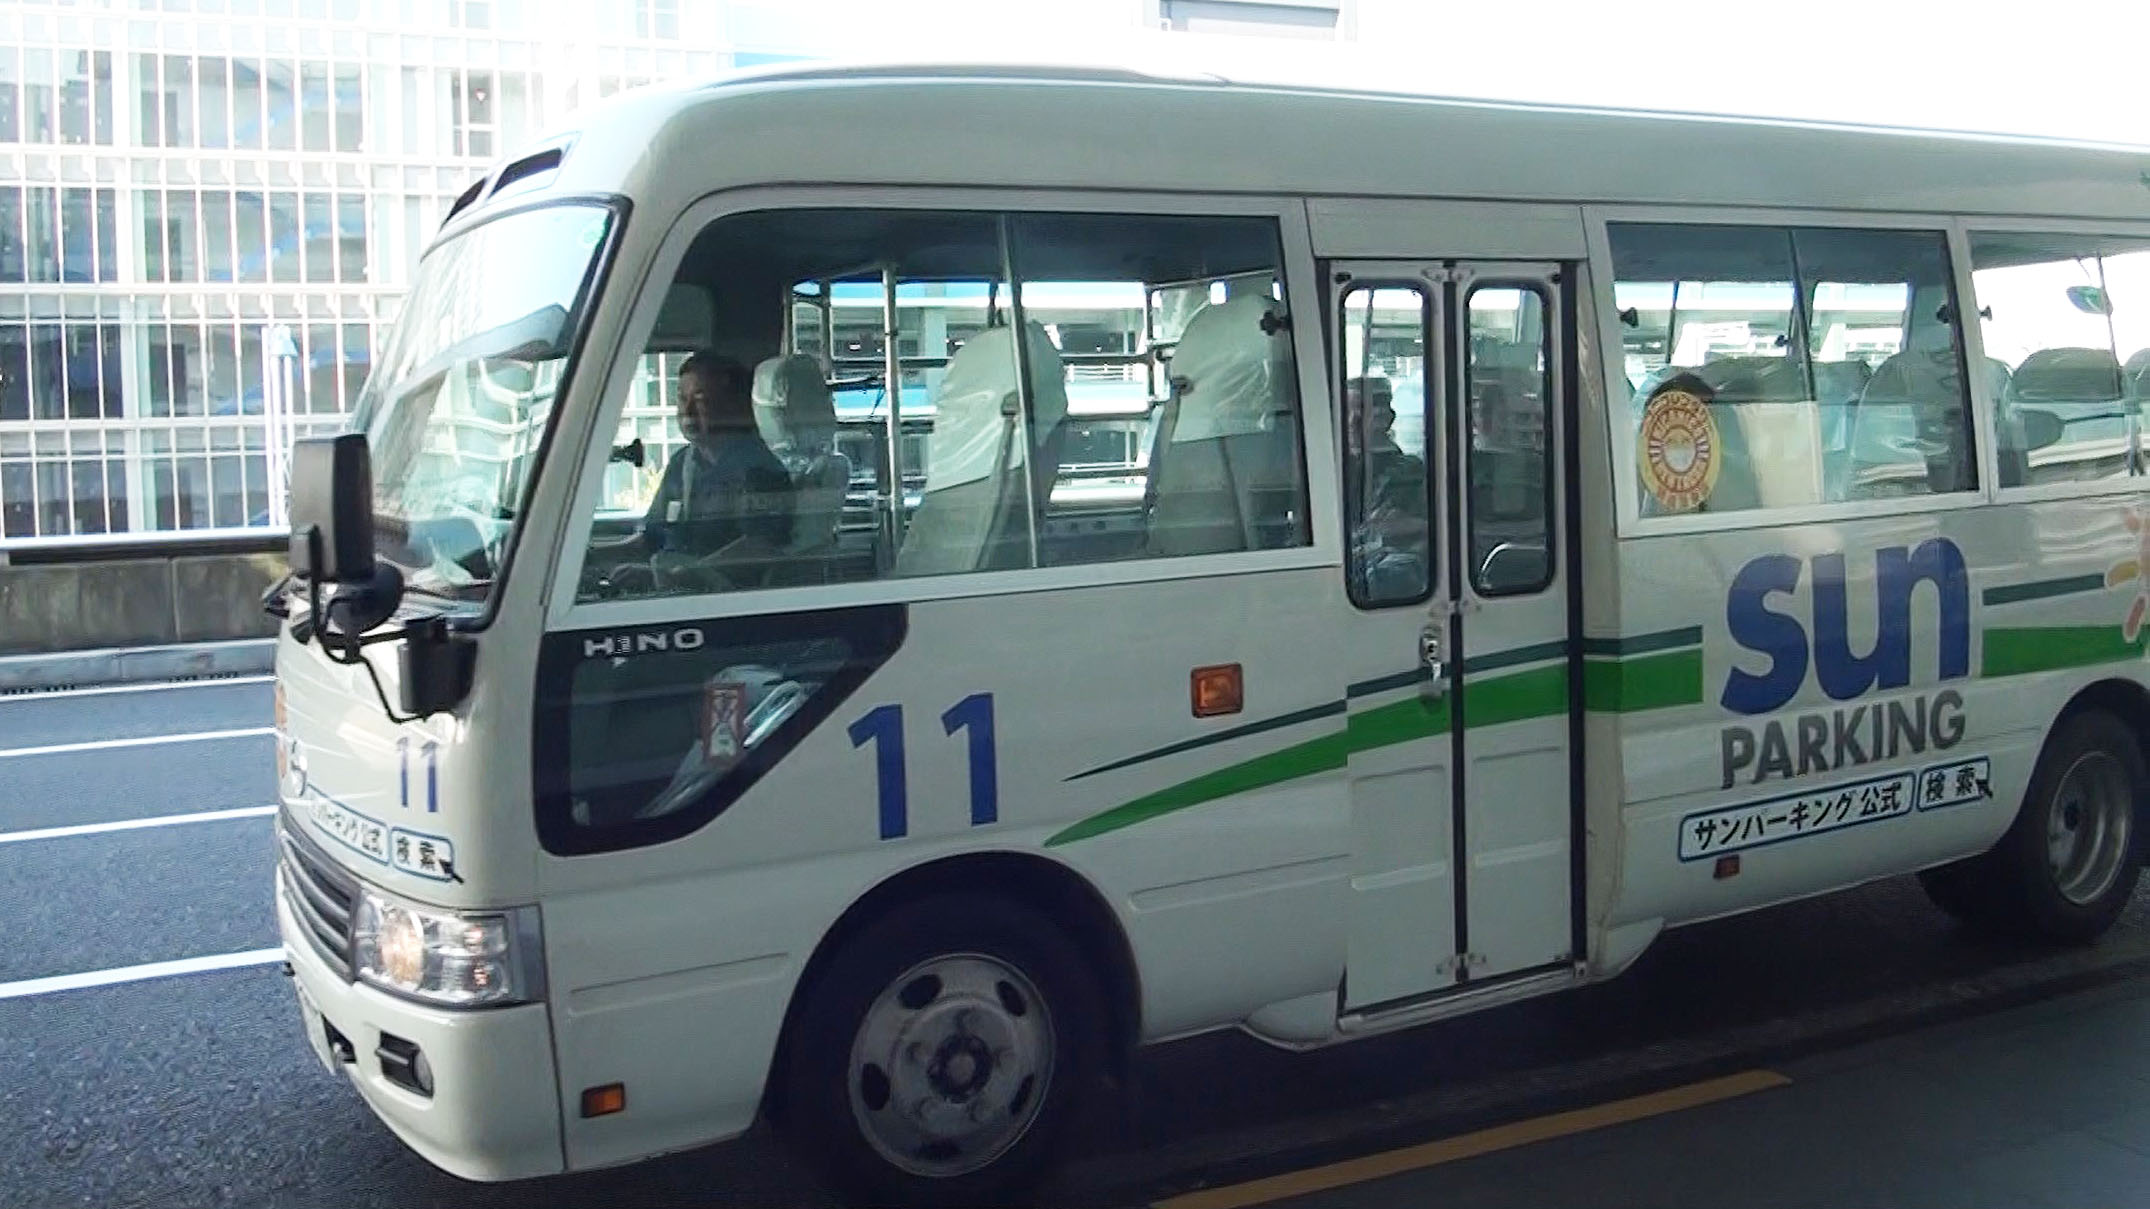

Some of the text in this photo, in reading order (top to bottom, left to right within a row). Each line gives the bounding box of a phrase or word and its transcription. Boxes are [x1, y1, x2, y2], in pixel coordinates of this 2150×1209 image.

[583, 628, 704, 657] HINO
[1720, 536, 1970, 715] sun
[397, 737, 438, 813] 11
[848, 692, 998, 841] 11
[1721, 689, 1966, 790] PARKING
